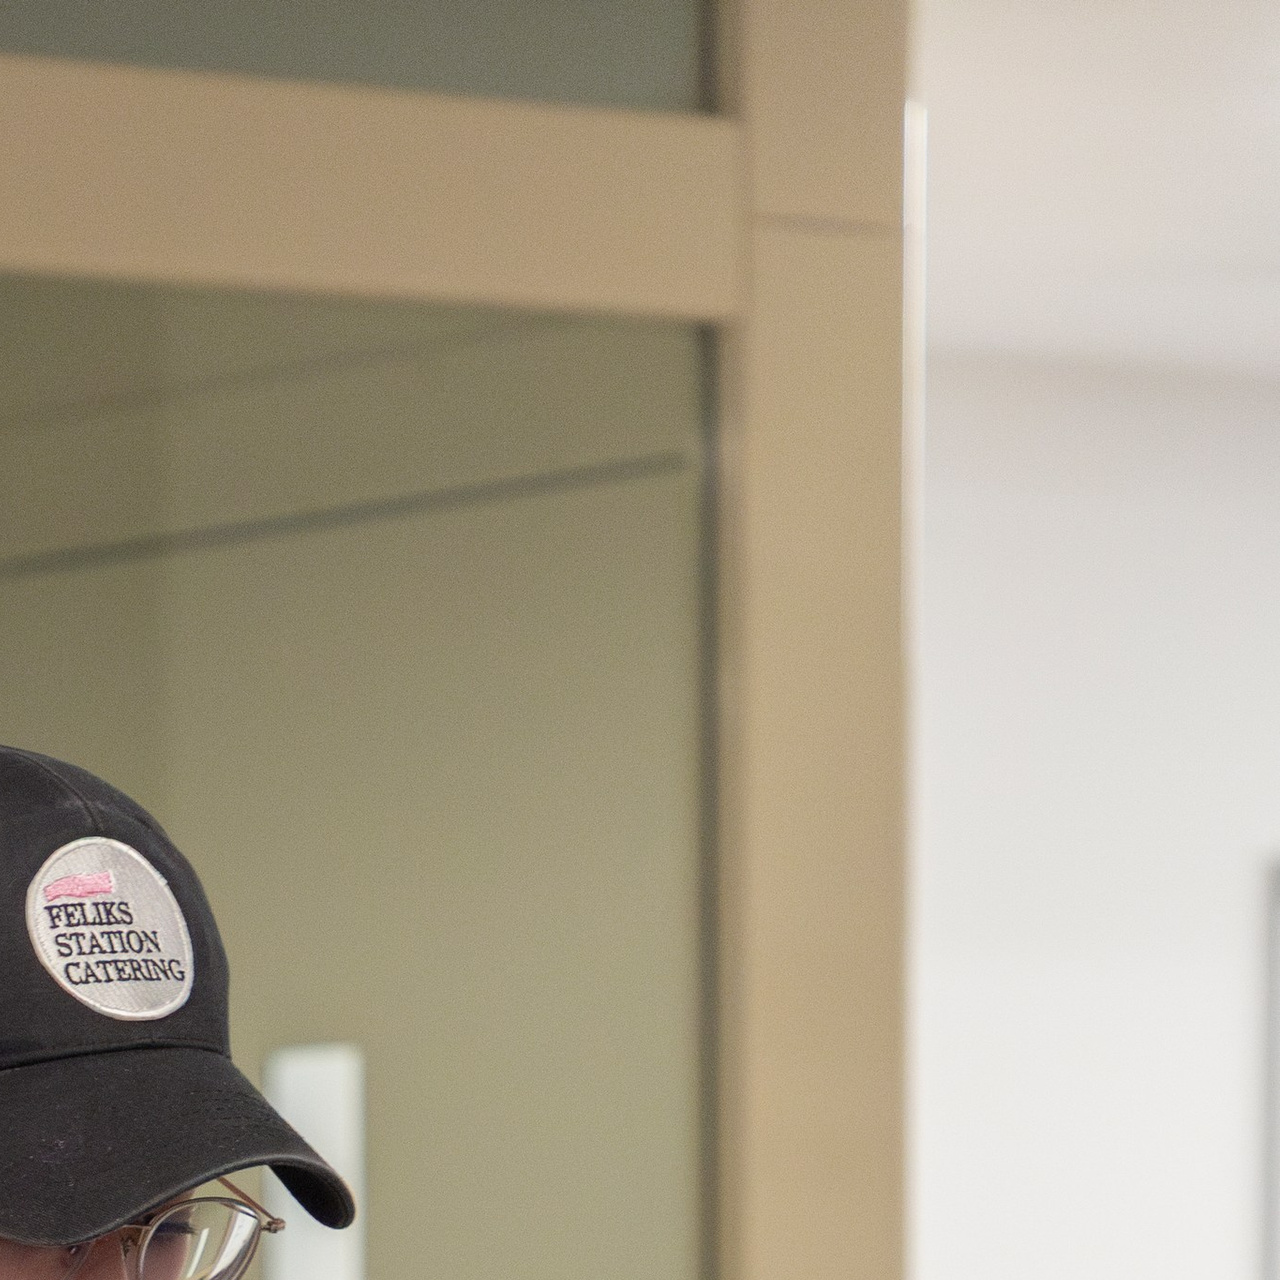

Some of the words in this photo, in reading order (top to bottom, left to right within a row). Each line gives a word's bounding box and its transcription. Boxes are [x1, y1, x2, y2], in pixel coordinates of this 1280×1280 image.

[44, 901, 134, 929] FELIKS
[55, 930, 162, 958] STATION
[64, 958, 186, 986] CATERING
